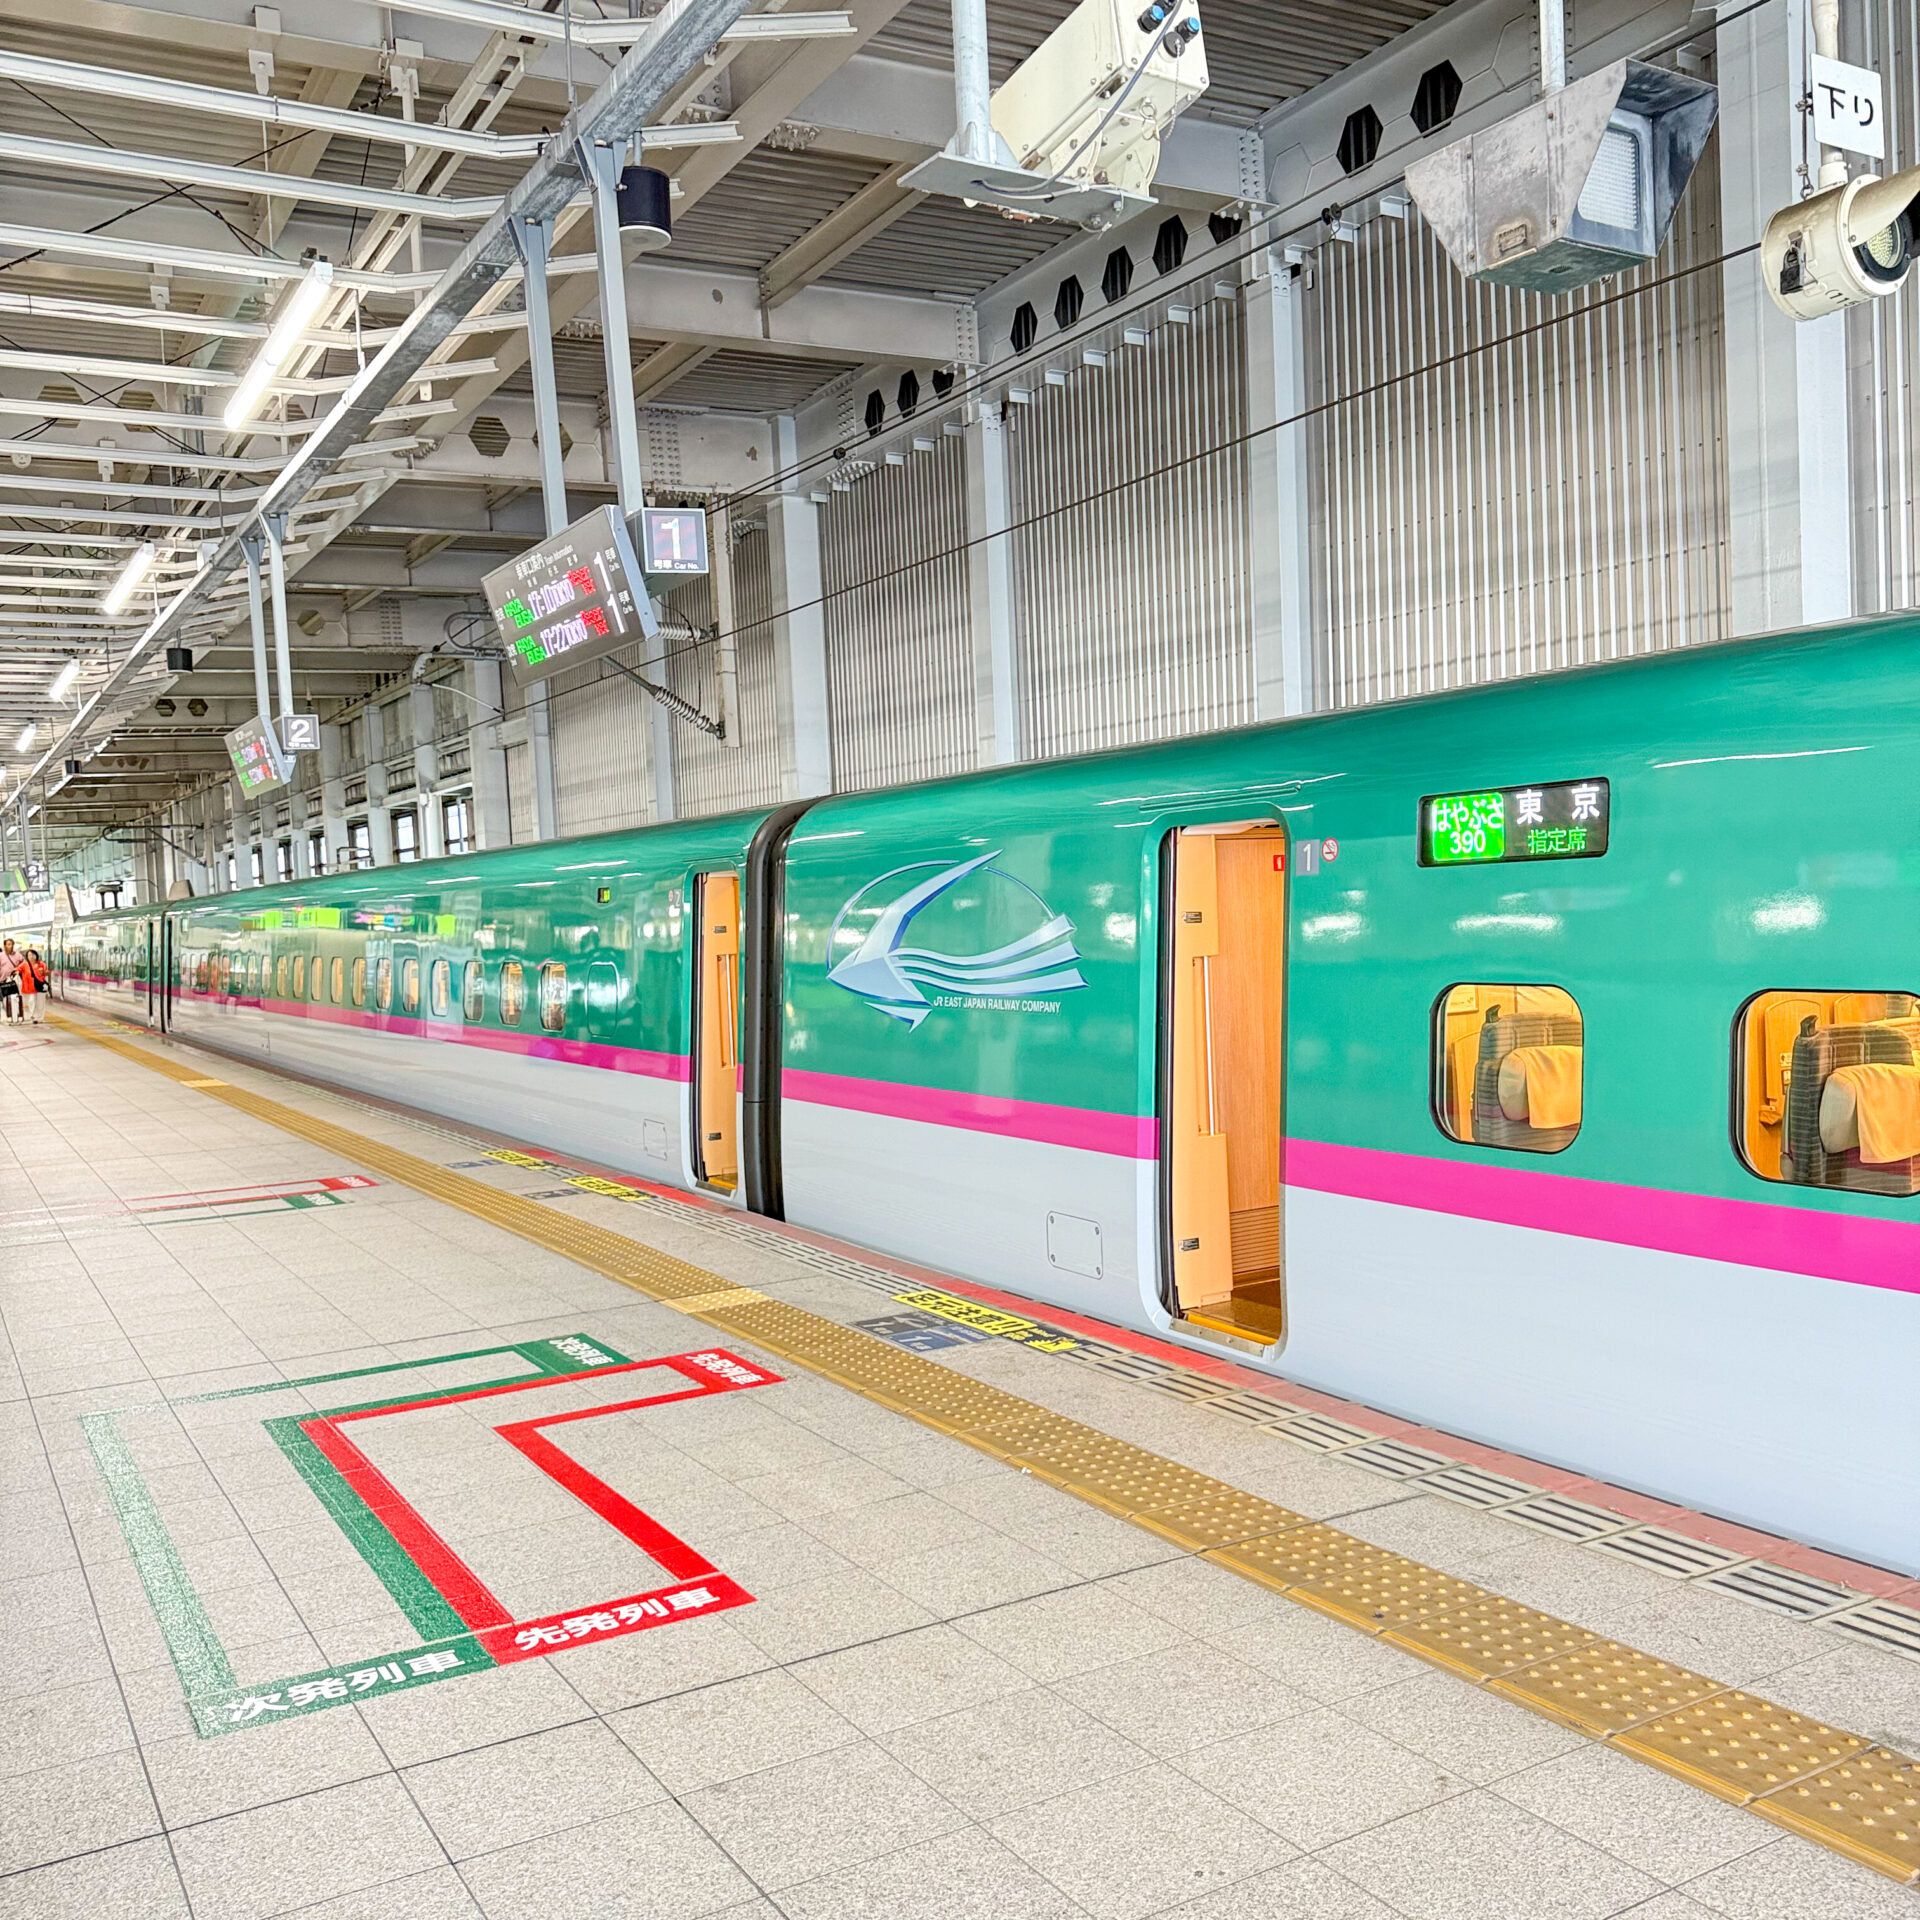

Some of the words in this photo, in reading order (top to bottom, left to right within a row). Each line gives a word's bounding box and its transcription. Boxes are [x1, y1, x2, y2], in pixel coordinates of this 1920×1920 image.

[1818, 83, 1874, 127] 下り
[661, 517, 681, 560] 1
[593, 551, 611, 591] 1
[674, 562, 687, 570] Car
[606, 593, 624, 633] 1
[291, 719, 311, 742] 2
[1432, 798, 1504, 832] はやぶさ
[1515, 783, 1600, 824] 東京
[1303, 843, 1311, 871] 1
[1449, 830, 1486, 854] 390
[1527, 826, 1588, 854] 指定席
[934, 996, 943, 1006] JR
[944, 996, 962, 1008] EAST
[963, 998, 986, 1009] JAPAN
[987, 998, 1020, 1011] RAILWAY
[1022, 1000, 1061, 1013] COMPANY
[513, 1586, 721, 1652] 先発列車
[228, 1648, 466, 1723] 次発列車
